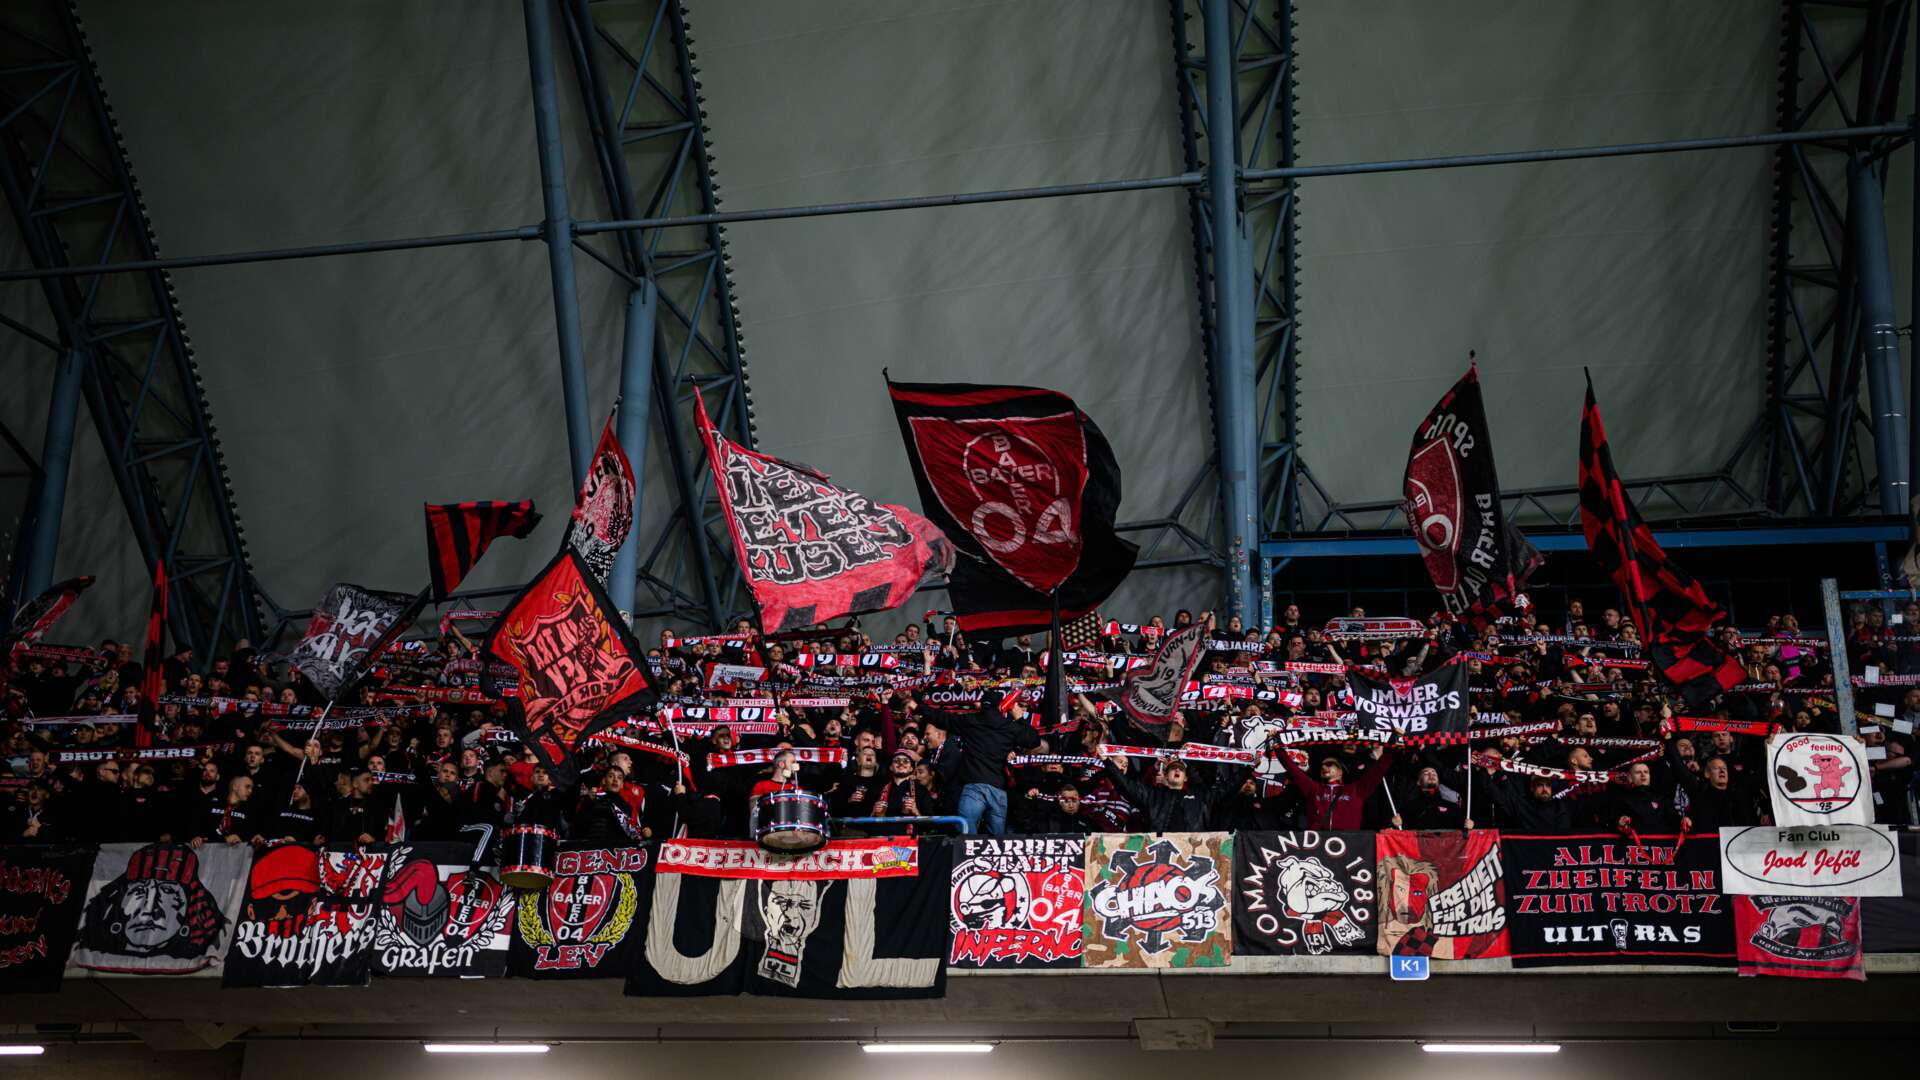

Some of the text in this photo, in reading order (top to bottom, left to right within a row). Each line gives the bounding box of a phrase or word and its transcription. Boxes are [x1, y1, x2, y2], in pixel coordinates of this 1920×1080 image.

[971, 463, 1053, 485] BAYER
[992, 435, 1033, 515] BAYER
[972, 498, 1078, 553] 04
[1354, 690, 1461, 717] VORWÄRTS
[1374, 716, 1429, 732] SVB
[1281, 729, 1392, 745] ULTRAS LEV
[1786, 737, 1809, 753] good
[1811, 743, 1843, 753] feeling
[1575, 770, 1610, 784] 513
[1779, 831, 1840, 842] Fan Club
[965, 839, 1084, 856] FARBEN
[1554, 845, 1675, 866] ALLEN
[556, 847, 648, 873] GEND
[974, 855, 1075, 874] STADT
[1762, 849, 1861, 876] Jood Jeföl
[1242, 830, 1346, 945] COMMANDO
[1429, 843, 1504, 911] FREIHEIT
[554, 891, 602, 905] BAYER
[570, 875, 591, 923] BAYER
[1044, 883, 1083, 901] BAYER
[1093, 869, 1219, 919] CHAOS
[1345, 856, 1375, 922] 1989
[450, 892, 490, 910] BAYER
[1471, 886, 1497, 916] DIE
[1601, 892, 1722, 914] TROTZ
[1182, 909, 1215, 930] 513
[1433, 907, 1506, 936] ULTRAS
[446, 925, 470, 938] 04
[556, 925, 584, 941] 04
[1308, 934, 1325, 946] LEV
[236, 918, 376, 978] Brothers
[535, 943, 608, 970] LEV
[1401, 959, 1420, 972] K1
